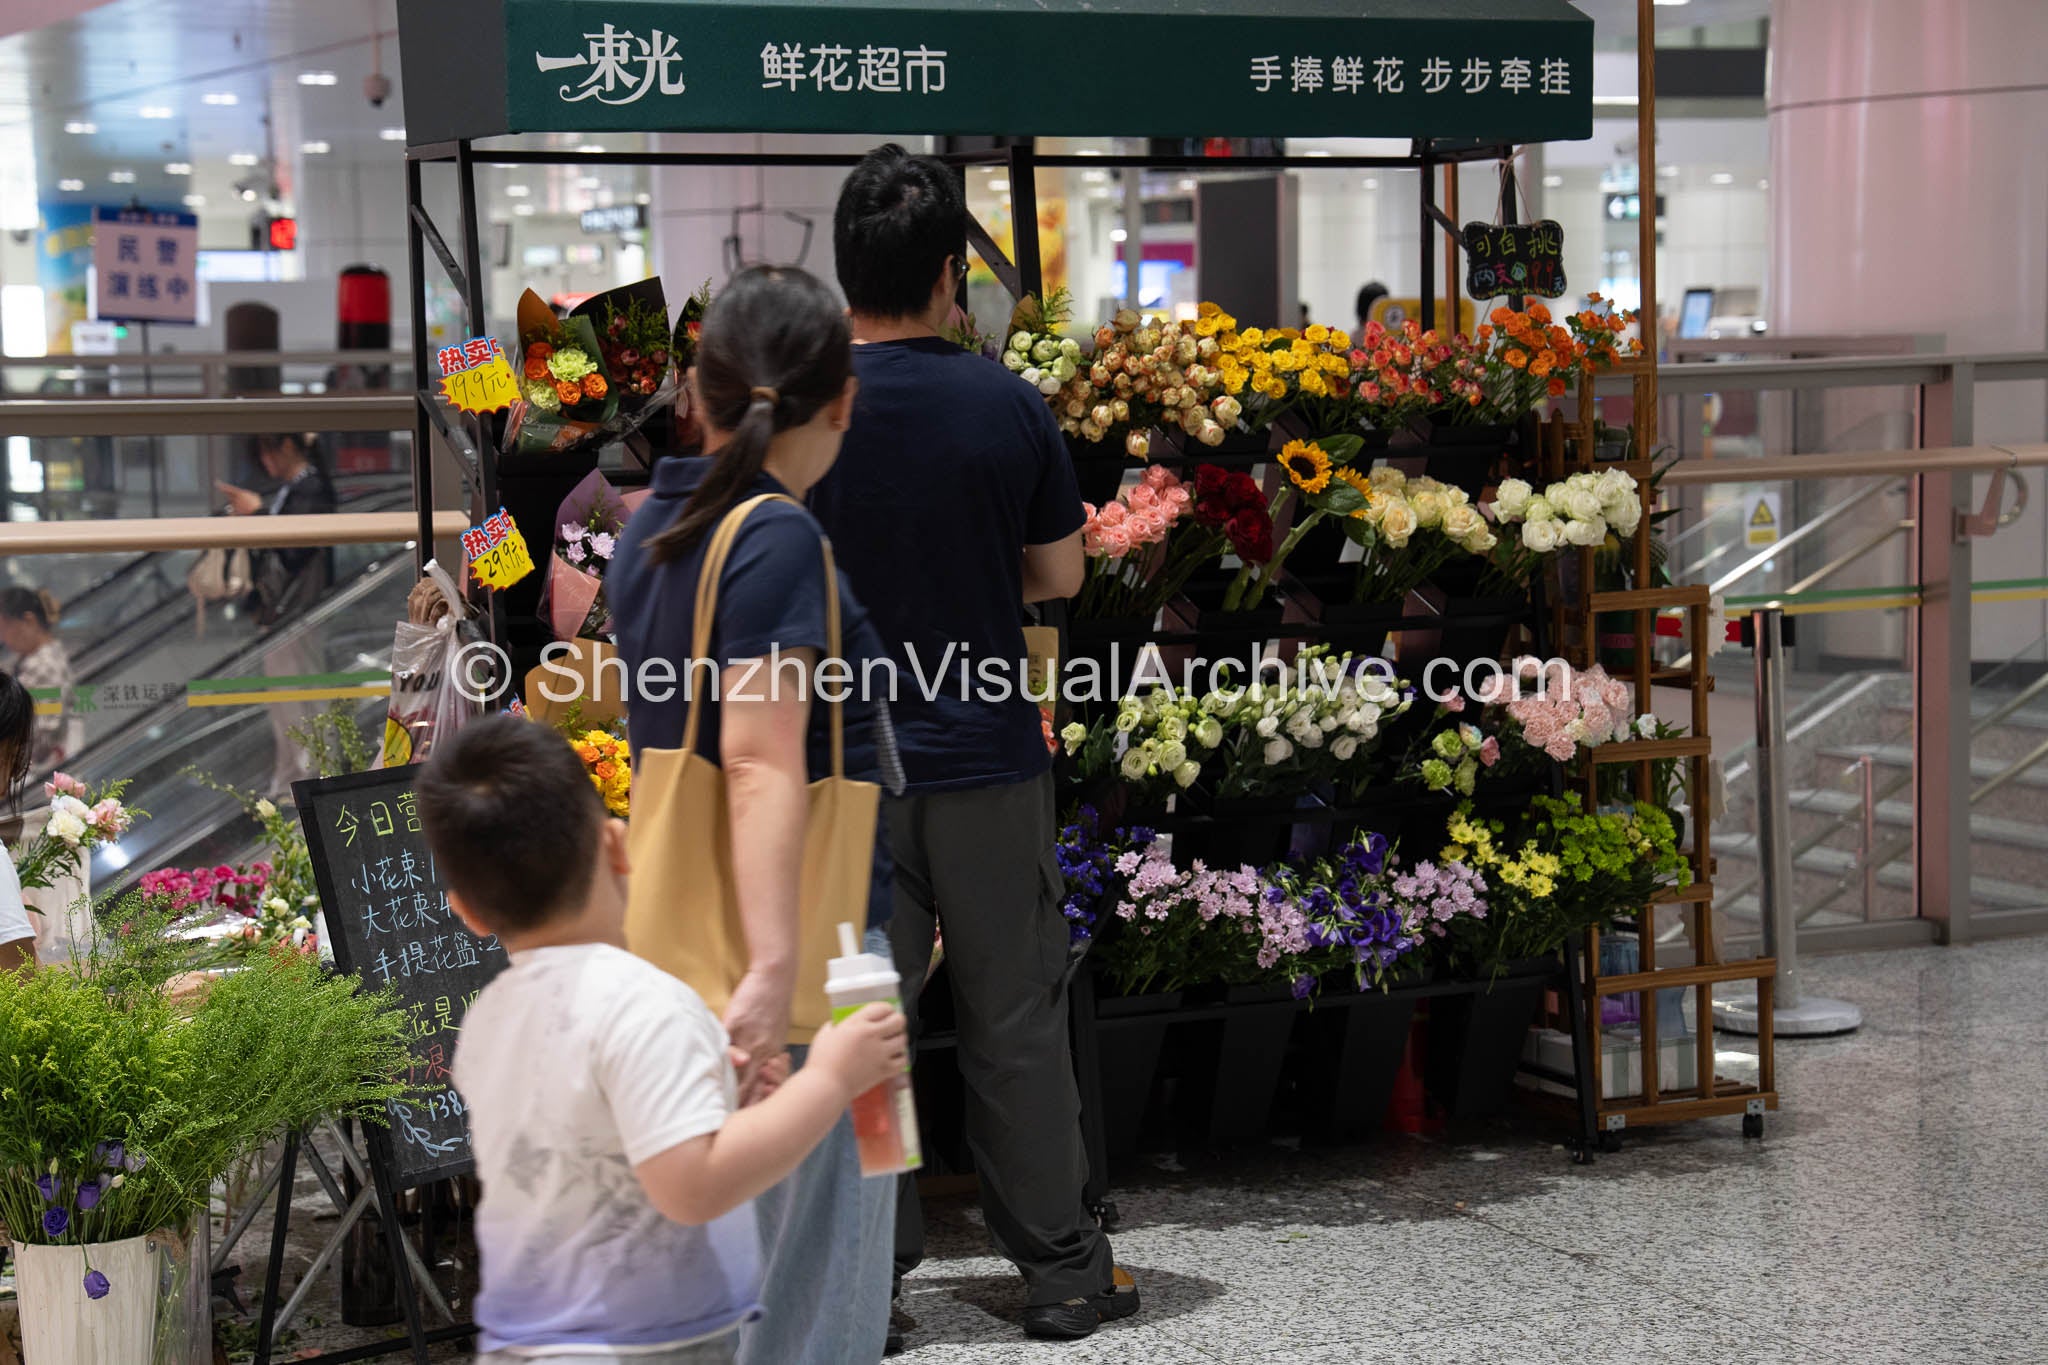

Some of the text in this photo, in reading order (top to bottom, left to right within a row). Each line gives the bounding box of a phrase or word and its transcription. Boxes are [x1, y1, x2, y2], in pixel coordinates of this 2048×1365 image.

[536, 23, 947, 105] 一束光 鲜花超市
[1250, 55, 1571, 95] 手捧鲜花 步步牵挂
[428, 1089, 470, 1122] 138
